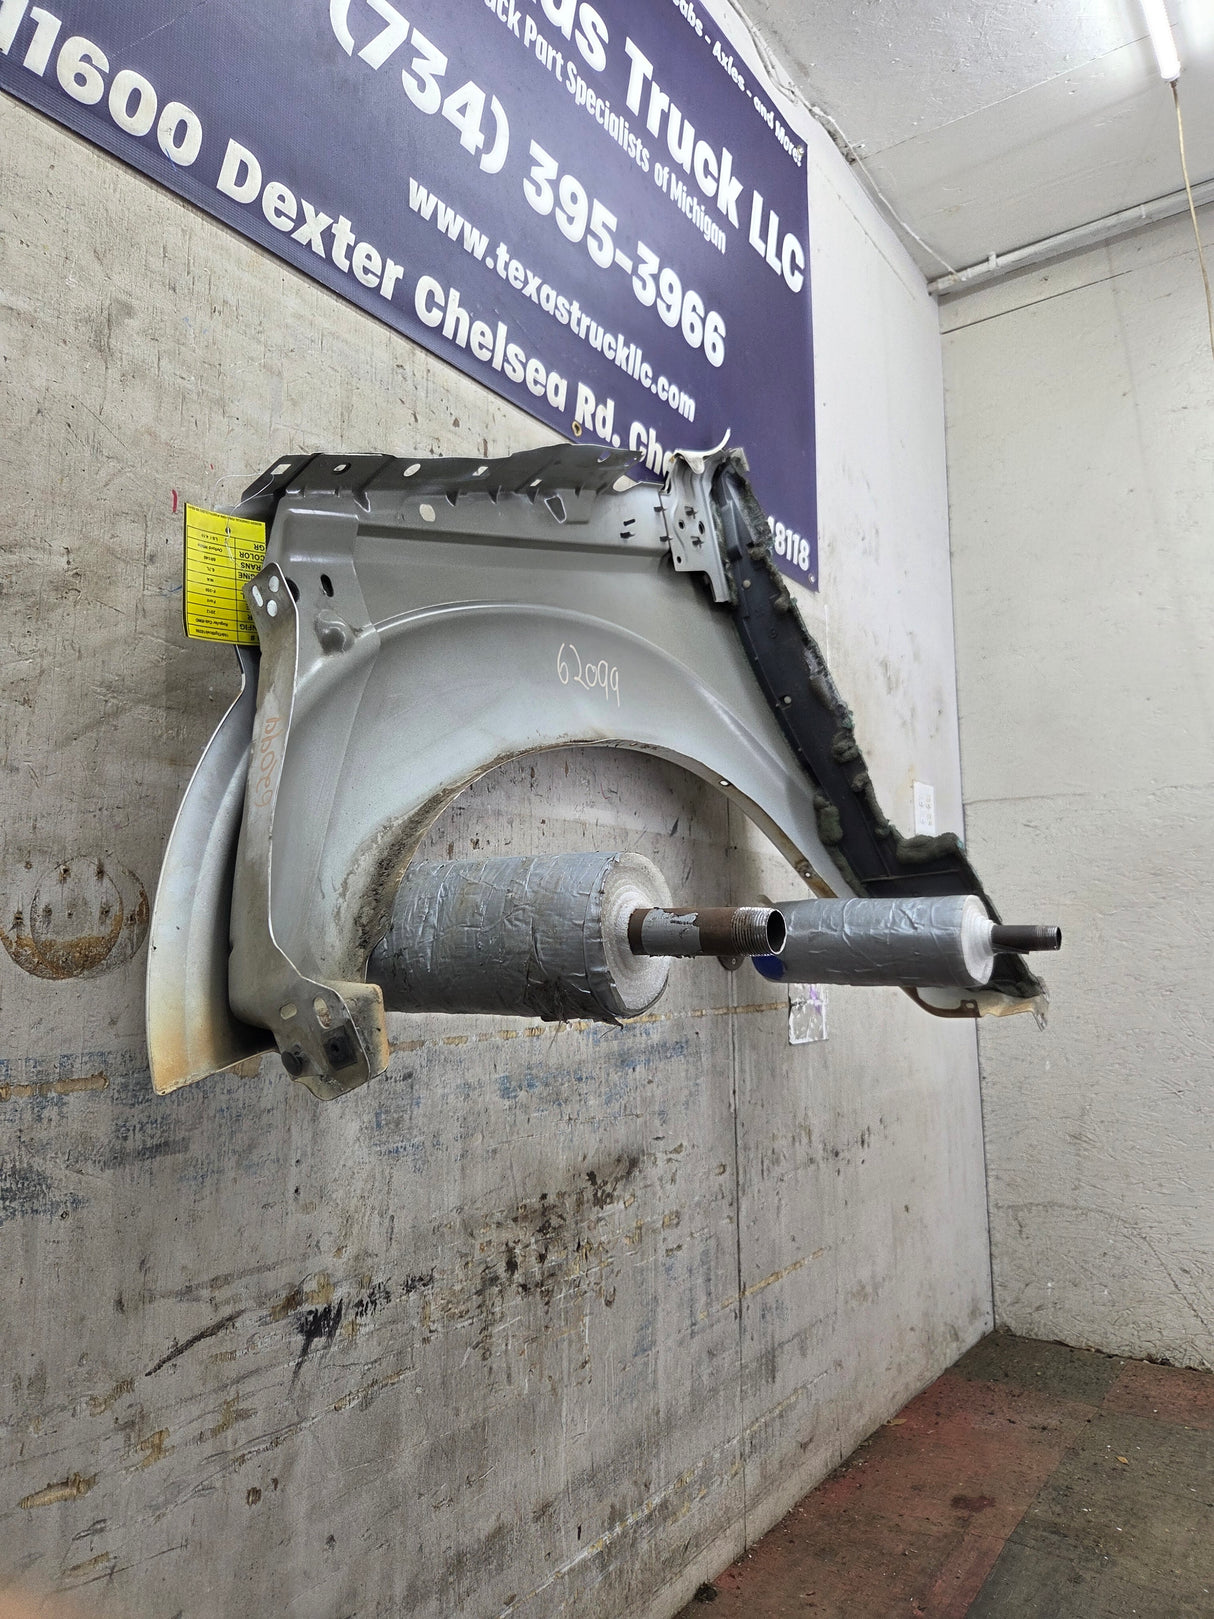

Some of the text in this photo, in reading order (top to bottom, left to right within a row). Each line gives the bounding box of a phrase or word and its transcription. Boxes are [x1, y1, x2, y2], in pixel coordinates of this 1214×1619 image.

[329, 0, 727, 368] (734) 395-3966
[523, 14, 564, 82] Part
[565, 60, 651, 173] Specialists
[654, 162, 670, 193] of
[670, 172, 727, 255] Michigan
[532, 0, 806, 293] as Truck LLC
[673, 0, 703, 37] abs
[712, 41, 745, 91] Axles
[753, 96, 775, 129] and
[0, 0, 204, 167] 11600
[216, 138, 404, 301] Dexter
[414, 274, 568, 412] Chelsea
[574, 382, 621, 448] Rd.
[409, 177, 696, 422] www.texastruckllc.com
[557, 643, 620, 708] 62099
